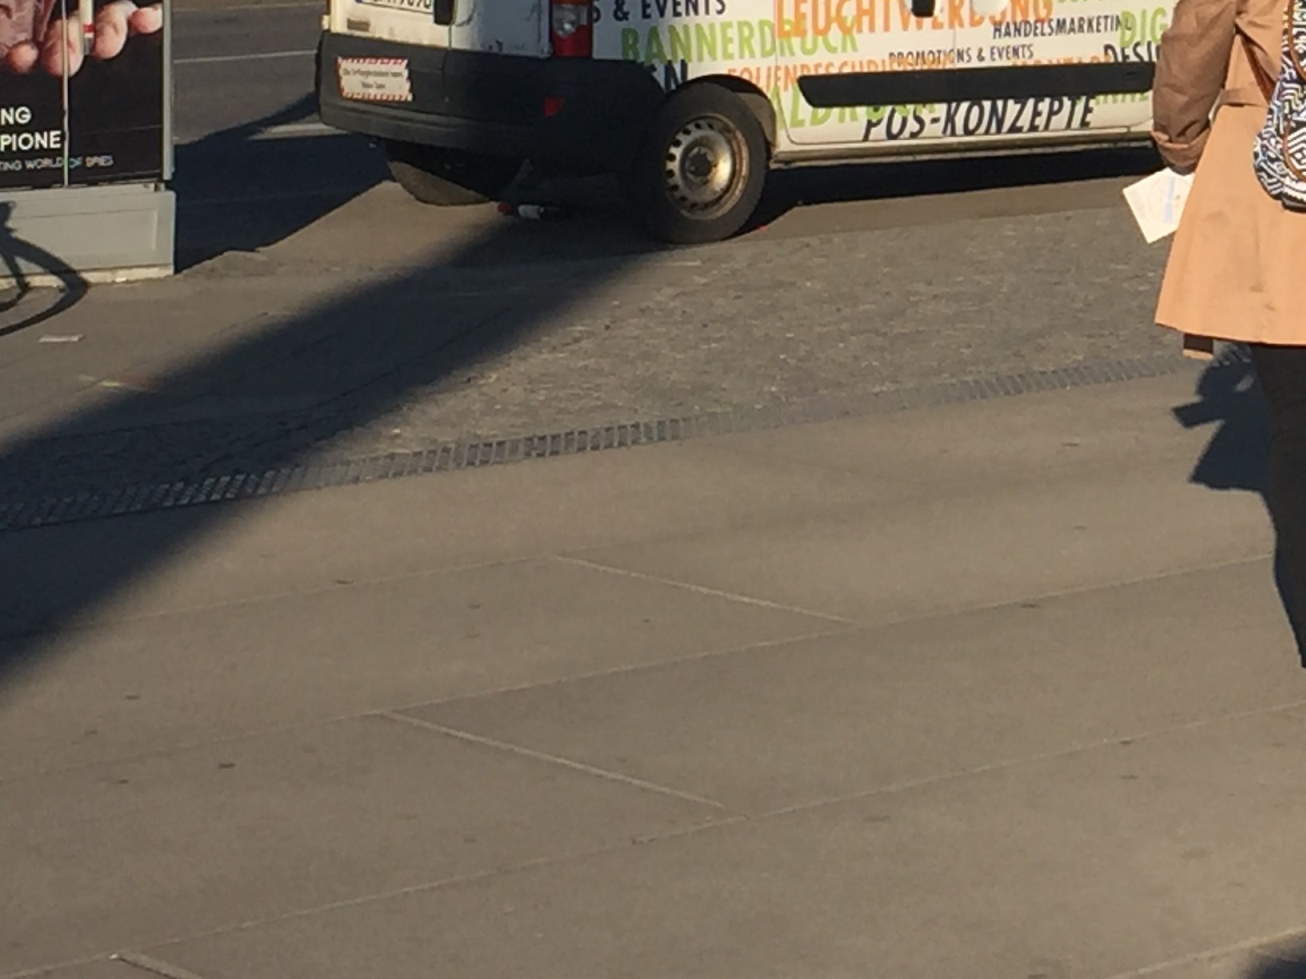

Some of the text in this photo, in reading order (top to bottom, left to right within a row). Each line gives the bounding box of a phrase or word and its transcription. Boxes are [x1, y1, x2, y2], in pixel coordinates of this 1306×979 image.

[620, 14, 859, 67] BANNERDRUCK
[990, 43, 1034, 61] EVENTS
[862, 94, 1096, 142] POS-KONZEPTE
